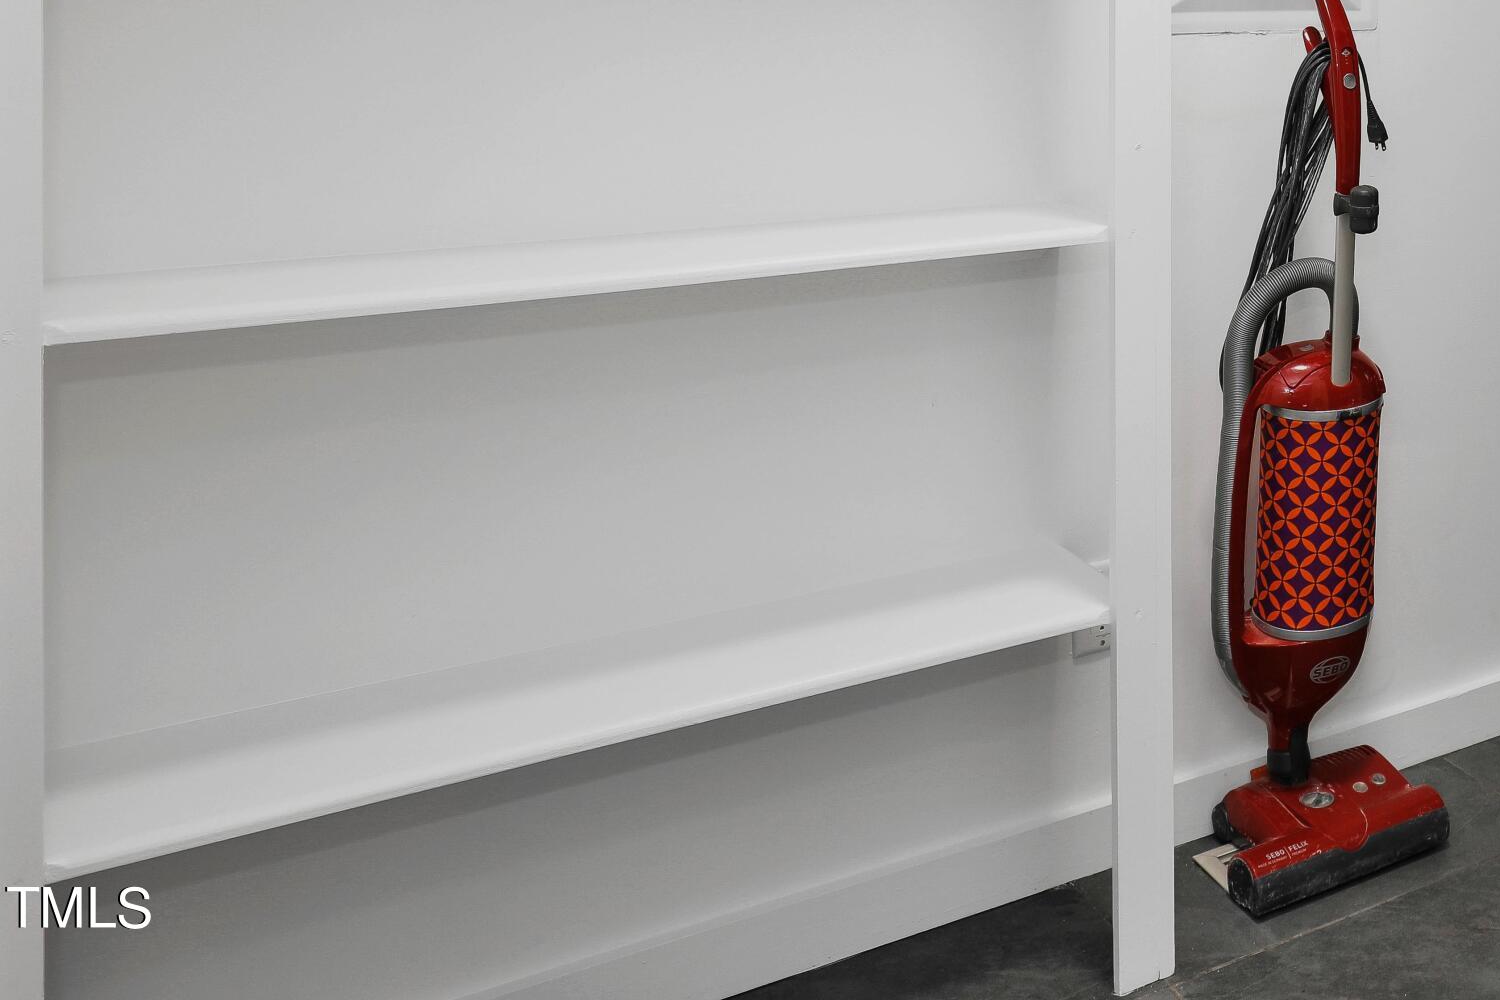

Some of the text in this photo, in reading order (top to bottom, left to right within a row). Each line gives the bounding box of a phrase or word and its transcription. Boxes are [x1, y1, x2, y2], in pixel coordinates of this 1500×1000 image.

[1312, 661, 1348, 679] SEBO
[1288, 840, 1309, 852] FELIX
[1265, 849, 1285, 860] SEBO
